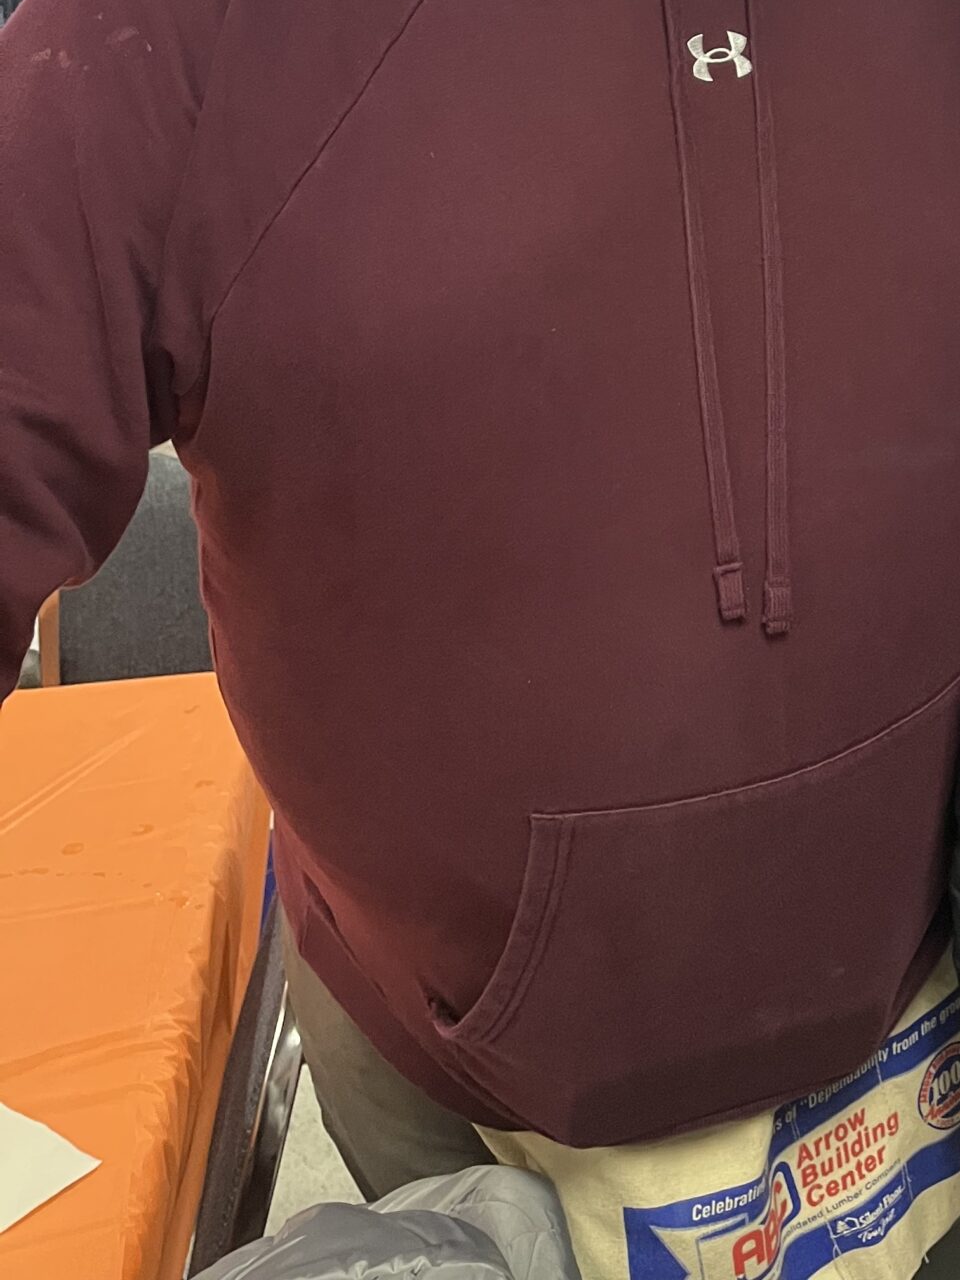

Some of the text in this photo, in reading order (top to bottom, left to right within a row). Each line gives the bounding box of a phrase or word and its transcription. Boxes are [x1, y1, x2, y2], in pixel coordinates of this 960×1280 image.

[892, 1029, 919, 1056] from
[920, 1015, 938, 1036] the
[796, 1107, 866, 1170] Arrow
[800, 1111, 900, 1189] Building
[805, 1145, 886, 1207] Center
[825, 1188, 863, 1214] Lumber
